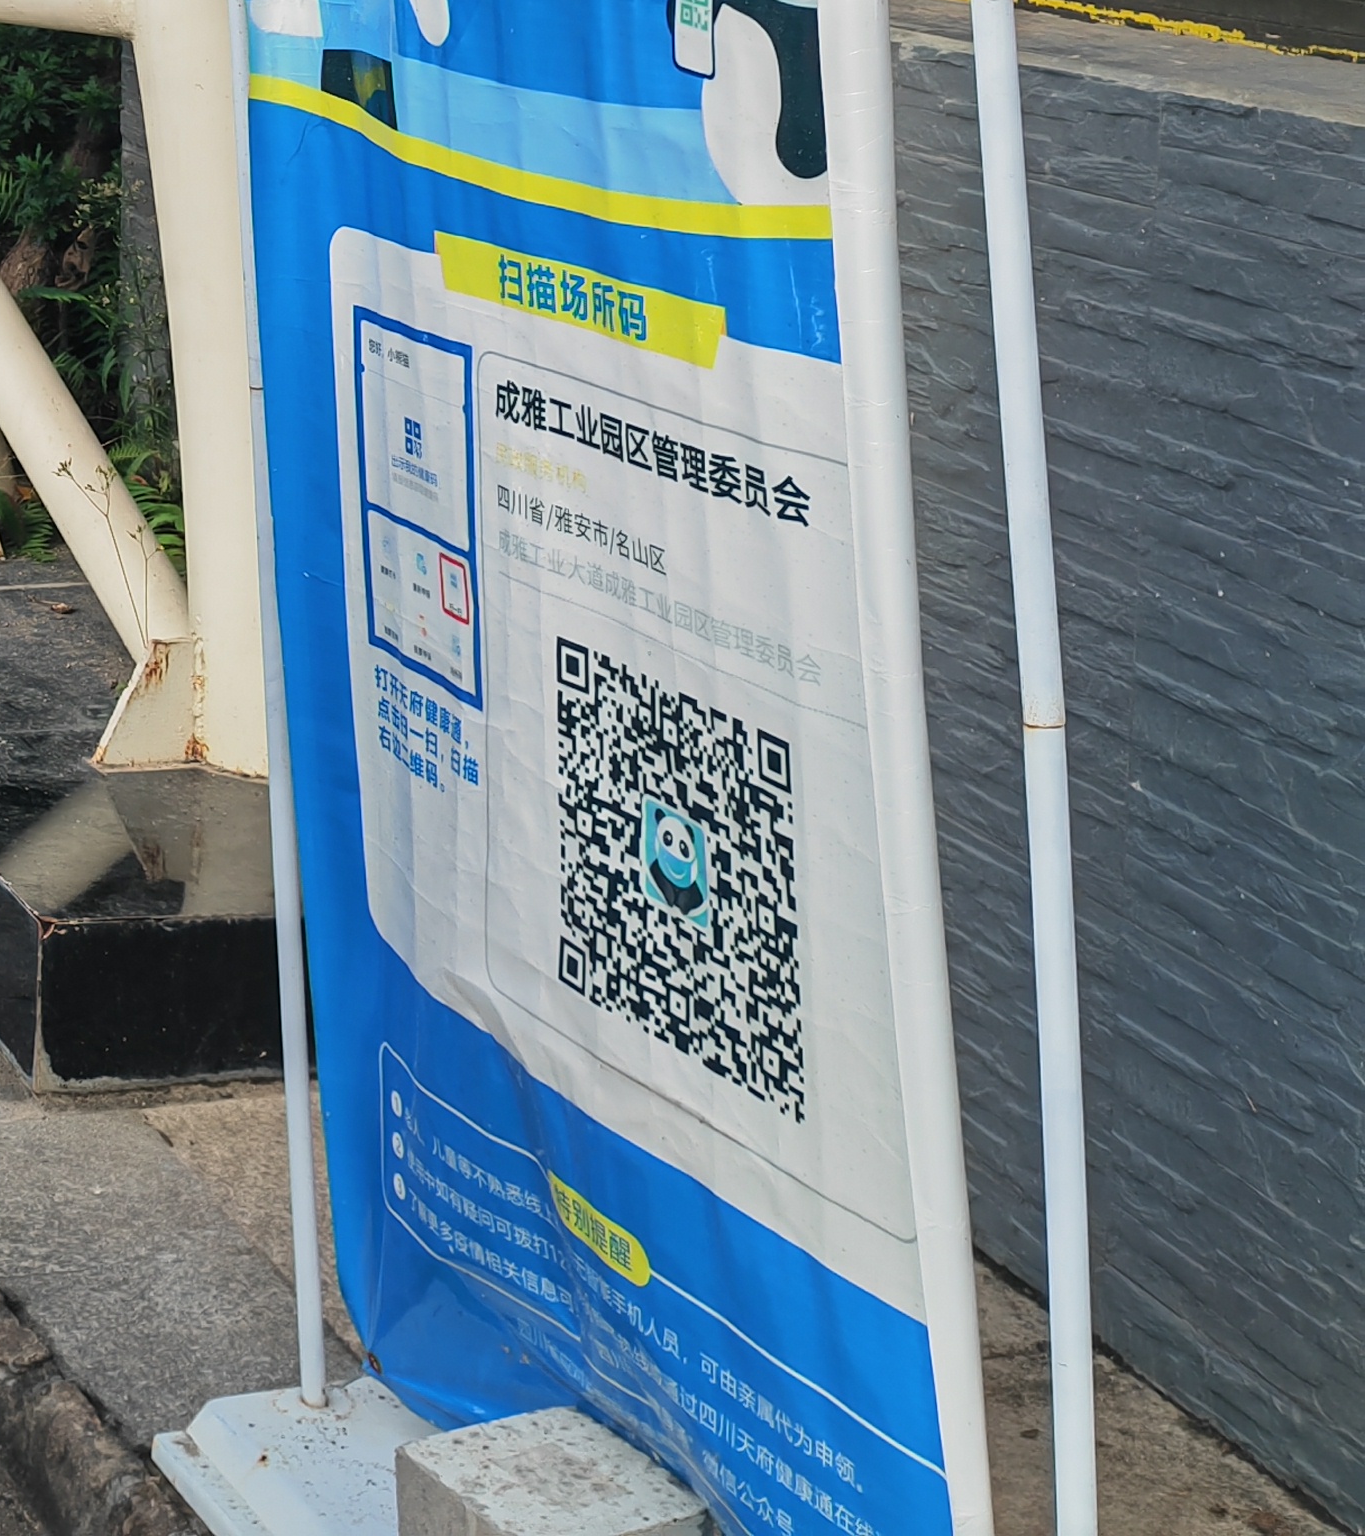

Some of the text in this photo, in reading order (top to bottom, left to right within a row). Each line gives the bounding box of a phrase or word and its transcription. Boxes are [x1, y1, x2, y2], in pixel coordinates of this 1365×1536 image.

[498, 254, 647, 342] 扫描场所码
[494, 378, 812, 528] 成雅工业园区管理委员会
[496, 483, 668, 576] 四川省/雅安市/名山区
[497, 527, 822, 687] 成雅工业大道成雅工业园区管理委员会
[553, 1181, 634, 1273] 特别提醒
